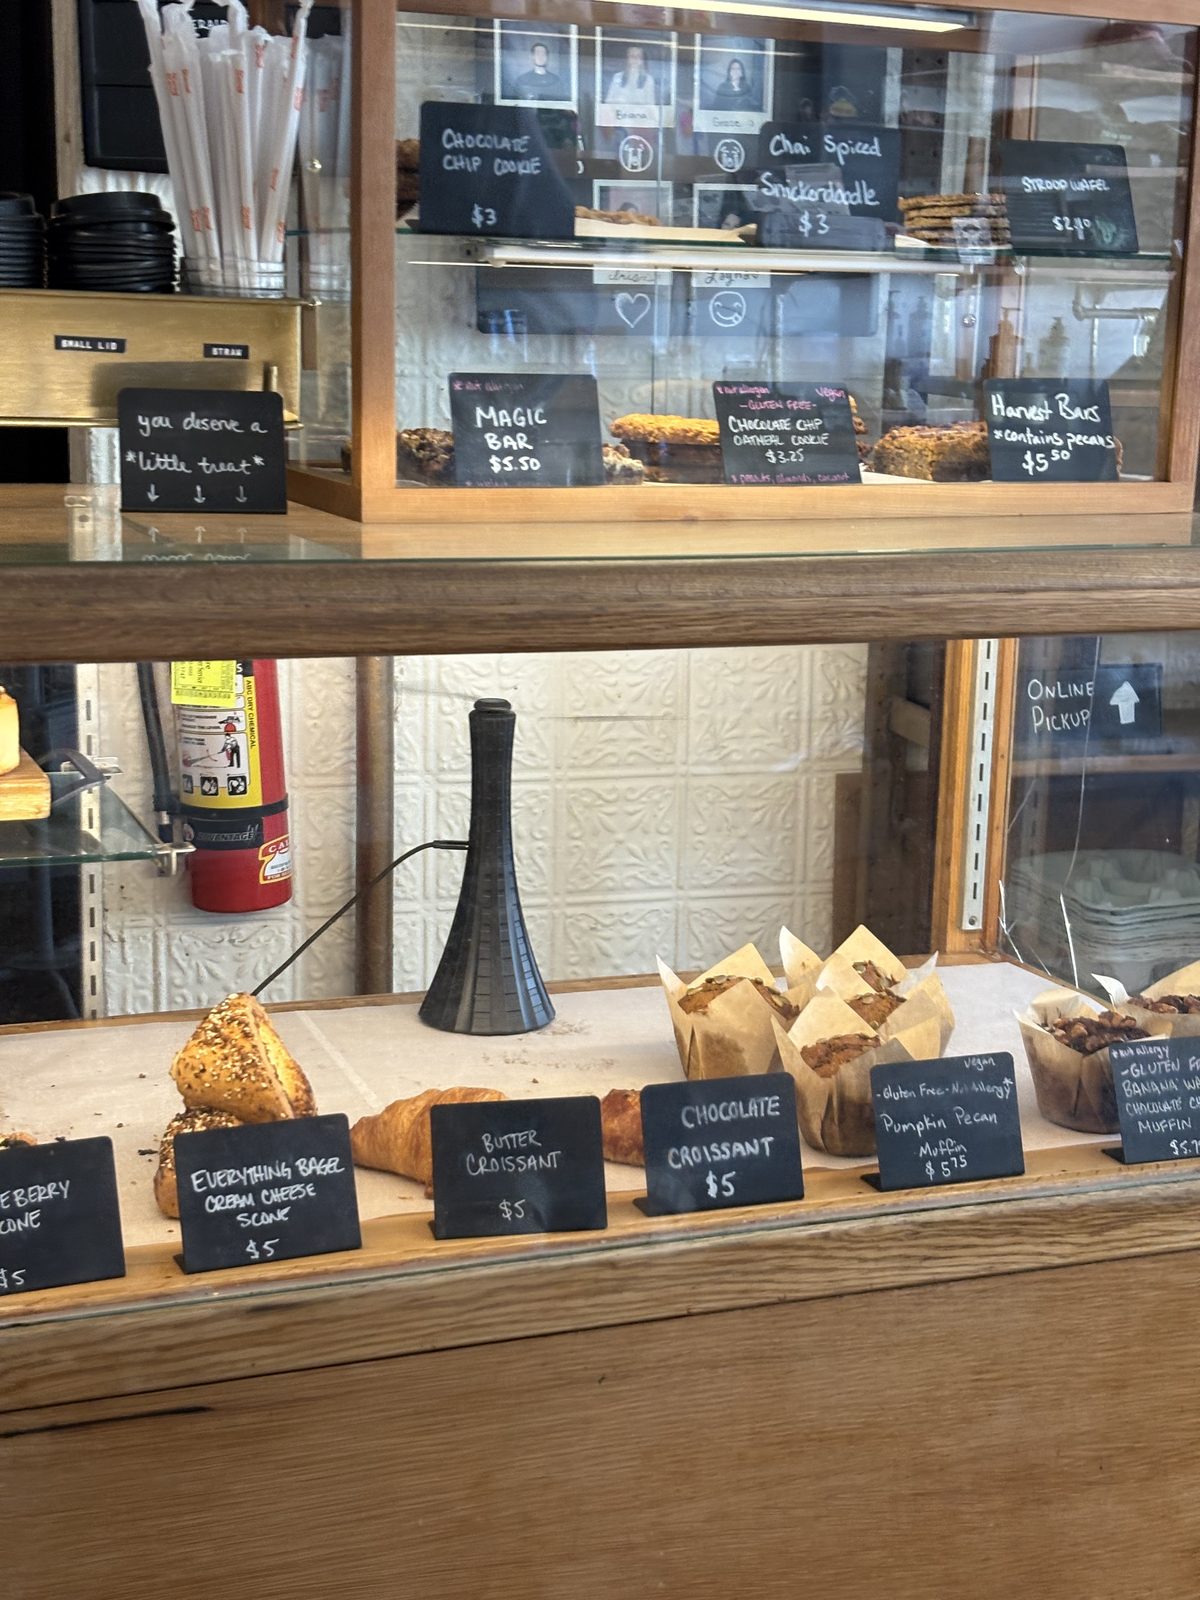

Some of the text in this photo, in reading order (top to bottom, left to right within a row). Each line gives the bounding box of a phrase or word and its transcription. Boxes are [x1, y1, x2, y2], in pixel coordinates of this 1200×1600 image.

[442, 128, 531, 152] CHOCOLATE
[769, 133, 882, 165] Chai Spiced
[442, 154, 541, 176] CHIP COOKIE
[760, 172, 880, 206] Snickerdoodle
[471, 203, 497, 229] $3
[798, 210, 830, 238] $3
[61, 339, 92, 350] SMALL
[212, 347, 243, 357] STRAW
[475, 406, 548, 428] MAGIC
[991, 393, 1101, 422] Harvest Bars
[138, 412, 268, 437] you deserve a
[728, 415, 823, 433] CHOCOLATE CHIP
[484, 432, 533, 451] BAR
[733, 433, 830, 446] OATMEAL COOKIE
[1066, 435, 1116, 451] pecans
[489, 454, 541, 474] $5.50
[765, 448, 805, 464] $3.25
[246, 680, 254, 695] ABC
[247, 697, 255, 711] DRY
[1031, 705, 1092, 734] PICKUP
[248, 713, 257, 749] CHEMICAL
[198, 831, 255, 842] VANTAGE
[1136, 1045, 1169, 1059] allergy
[964, 1056, 996, 1071] vegan
[1122, 1078, 1178, 1098] BANANA
[681, 1096, 780, 1129] CHOCOLATE
[1126, 1097, 1182, 1117] CHOCOLATE
[880, 1106, 997, 1137] Pumpkin Pecan
[1138, 1117, 1192, 1134] MUFFIN
[482, 1130, 542, 1153] BUTTER
[919, 1138, 967, 1157] Muffin
[466, 1151, 561, 1176] CROISSANT
[668, 1137, 774, 1169] CROISSANT
[191, 1157, 345, 1192] EVERYTHING BAGEL
[706, 1170, 736, 1198] $5
[205, 1183, 316, 1213] CREAM CHEESE
[236, 1207, 291, 1228] SCONE
[499, 1199, 526, 1221] $5
